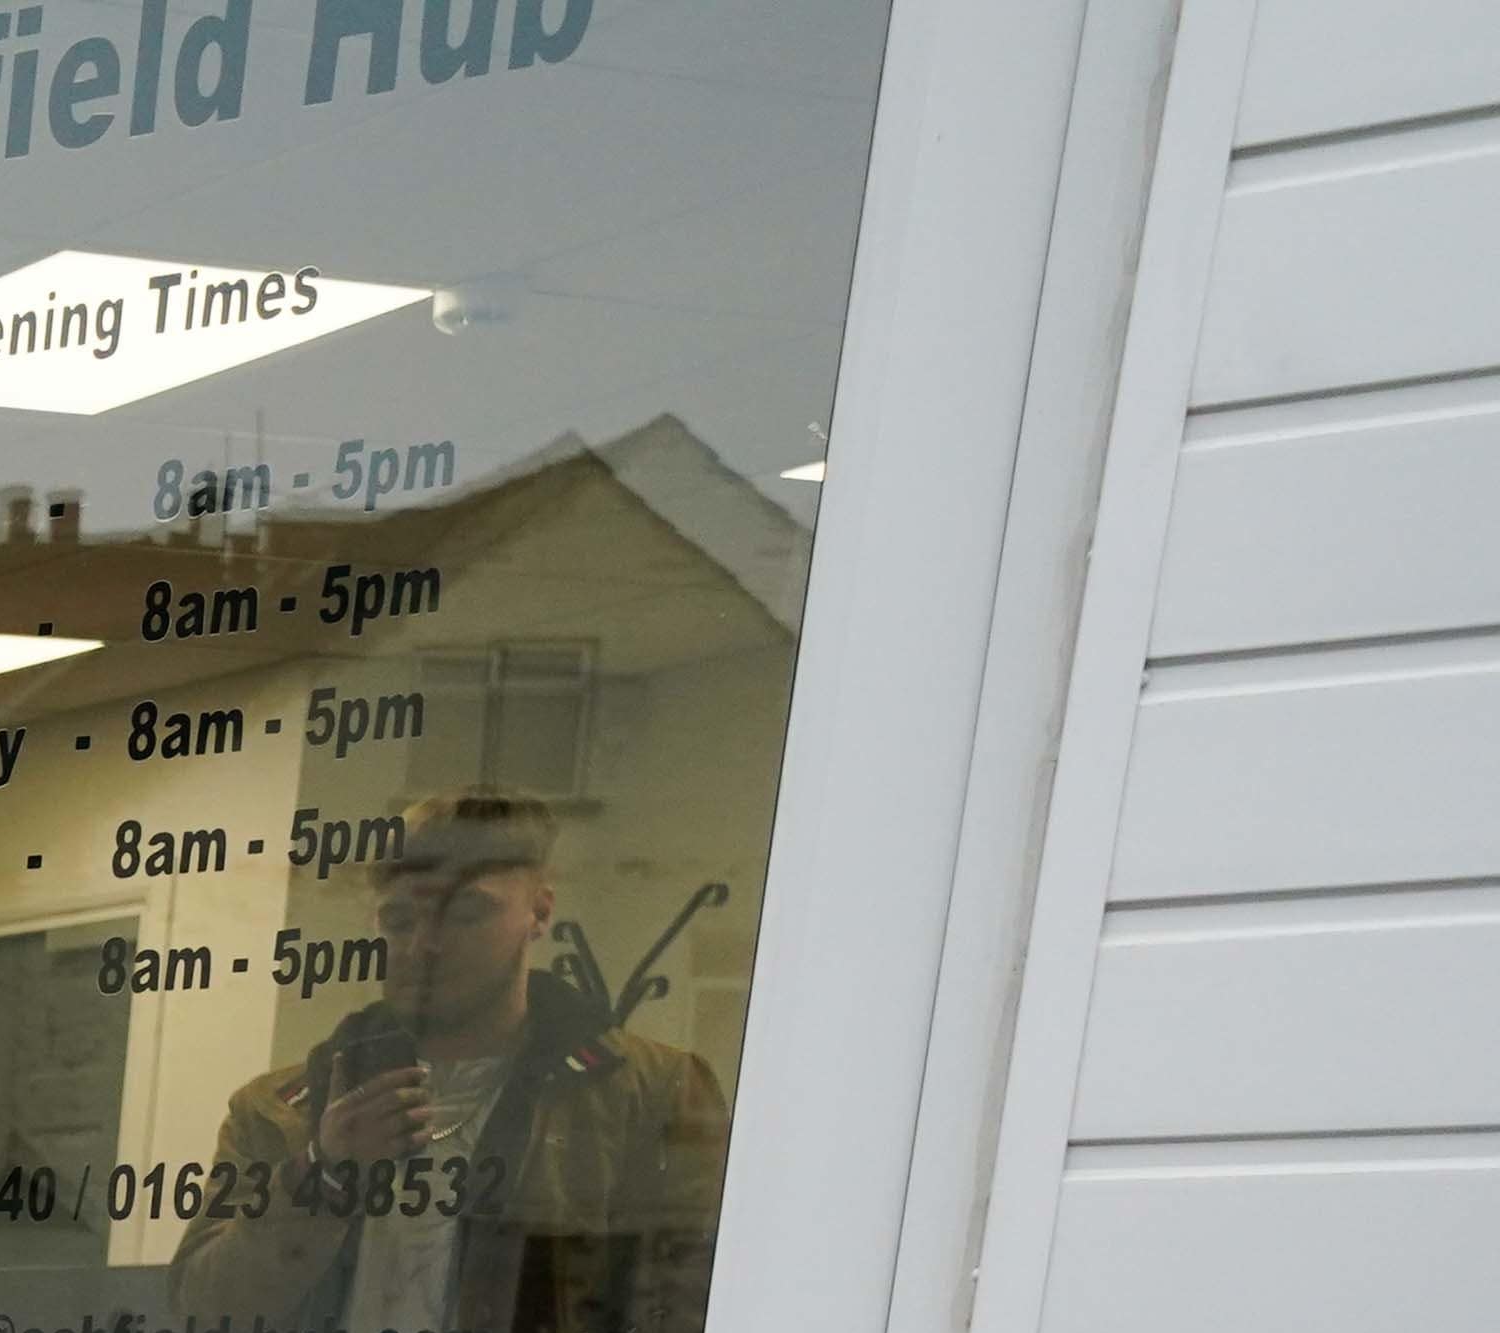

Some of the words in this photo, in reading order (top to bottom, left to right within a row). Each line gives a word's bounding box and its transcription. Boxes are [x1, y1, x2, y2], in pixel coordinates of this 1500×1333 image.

[303, 0, 593, 105] Hub
[148, 265, 320, 335] Times
[154, 459, 272, 522] 8am
[332, 438, 457, 512] 5pm
[142, 579, 260, 643] 8am
[320, 563, 441, 637] 5pm
[127, 701, 244, 762] 8am
[306, 688, 425, 760] 5pm
[112, 820, 228, 880] 8am
[287, 808, 405, 880] 5pm
[97, 936, 211, 996] 8am
[271, 928, 388, 999] 5pm
[73, 1162, 91, 1222] /
[106, 1160, 273, 1222] 01623
[291, 1156, 510, 1219] 438532
